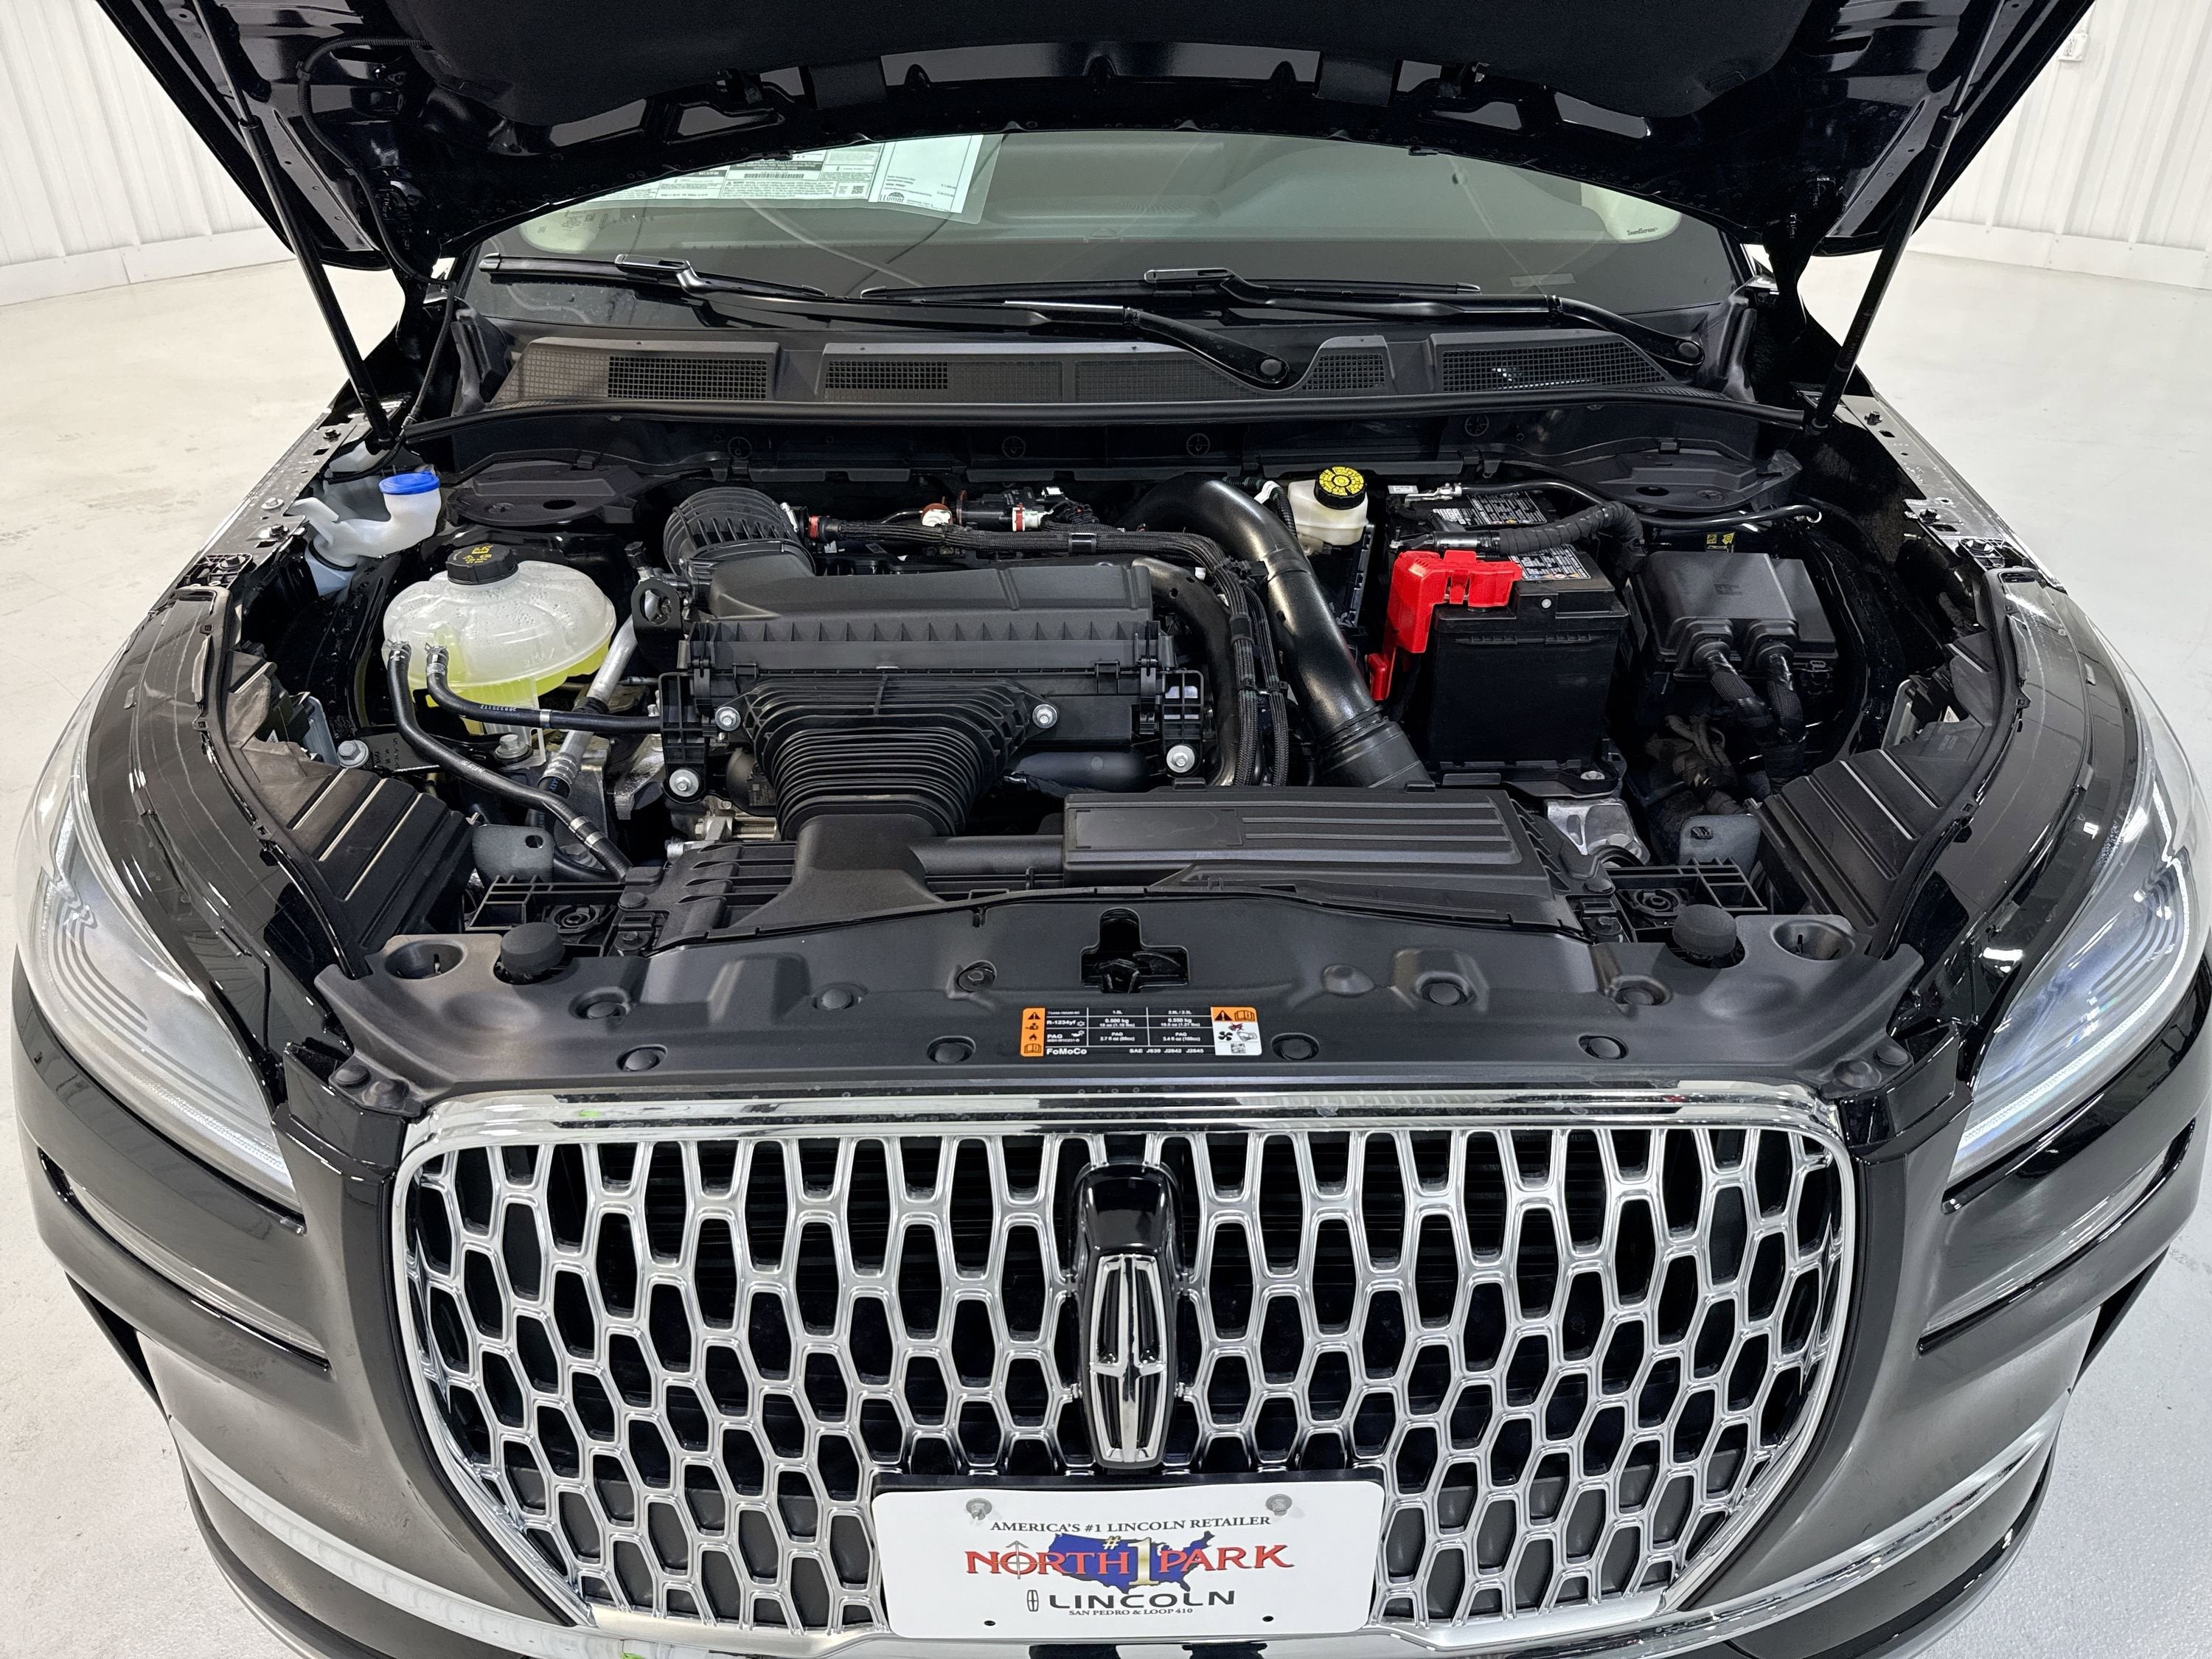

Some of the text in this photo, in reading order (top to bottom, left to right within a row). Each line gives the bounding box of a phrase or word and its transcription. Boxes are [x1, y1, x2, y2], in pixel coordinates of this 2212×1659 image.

[990, 1516, 1272, 1533] AMERICA'S #1 LINCOLN RETAILER
[964, 1551, 1130, 1575] NORTH
[1158, 1545, 1295, 1573] PARK
[1049, 1590, 1235, 1609] LINCOLN
